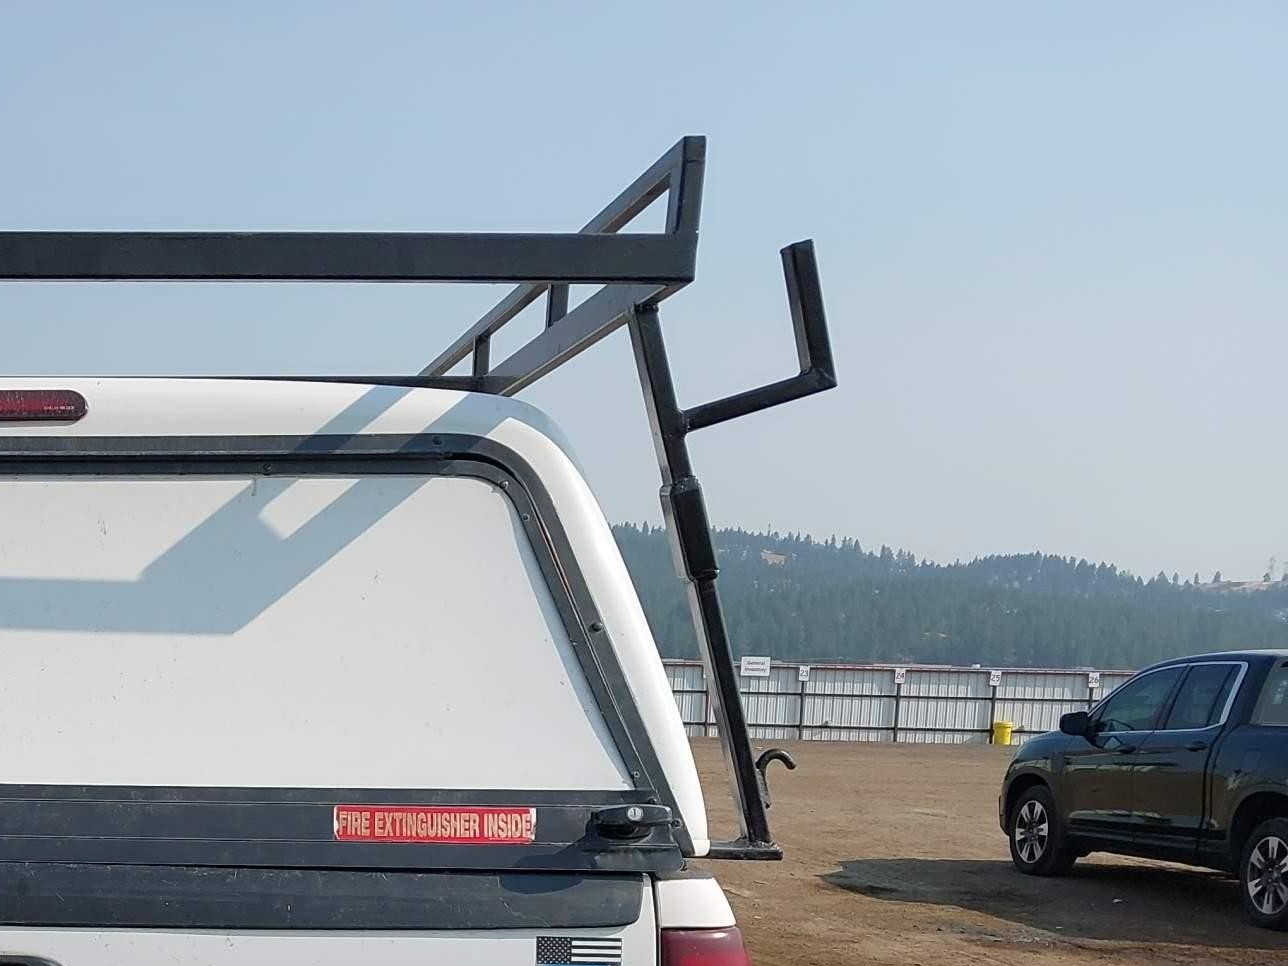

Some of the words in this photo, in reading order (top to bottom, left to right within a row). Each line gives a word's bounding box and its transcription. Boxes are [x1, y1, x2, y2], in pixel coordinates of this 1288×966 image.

[339, 810, 371, 837] FIRE
[374, 811, 480, 838] EXTINGUISHER
[484, 812, 532, 839] INSIDE
